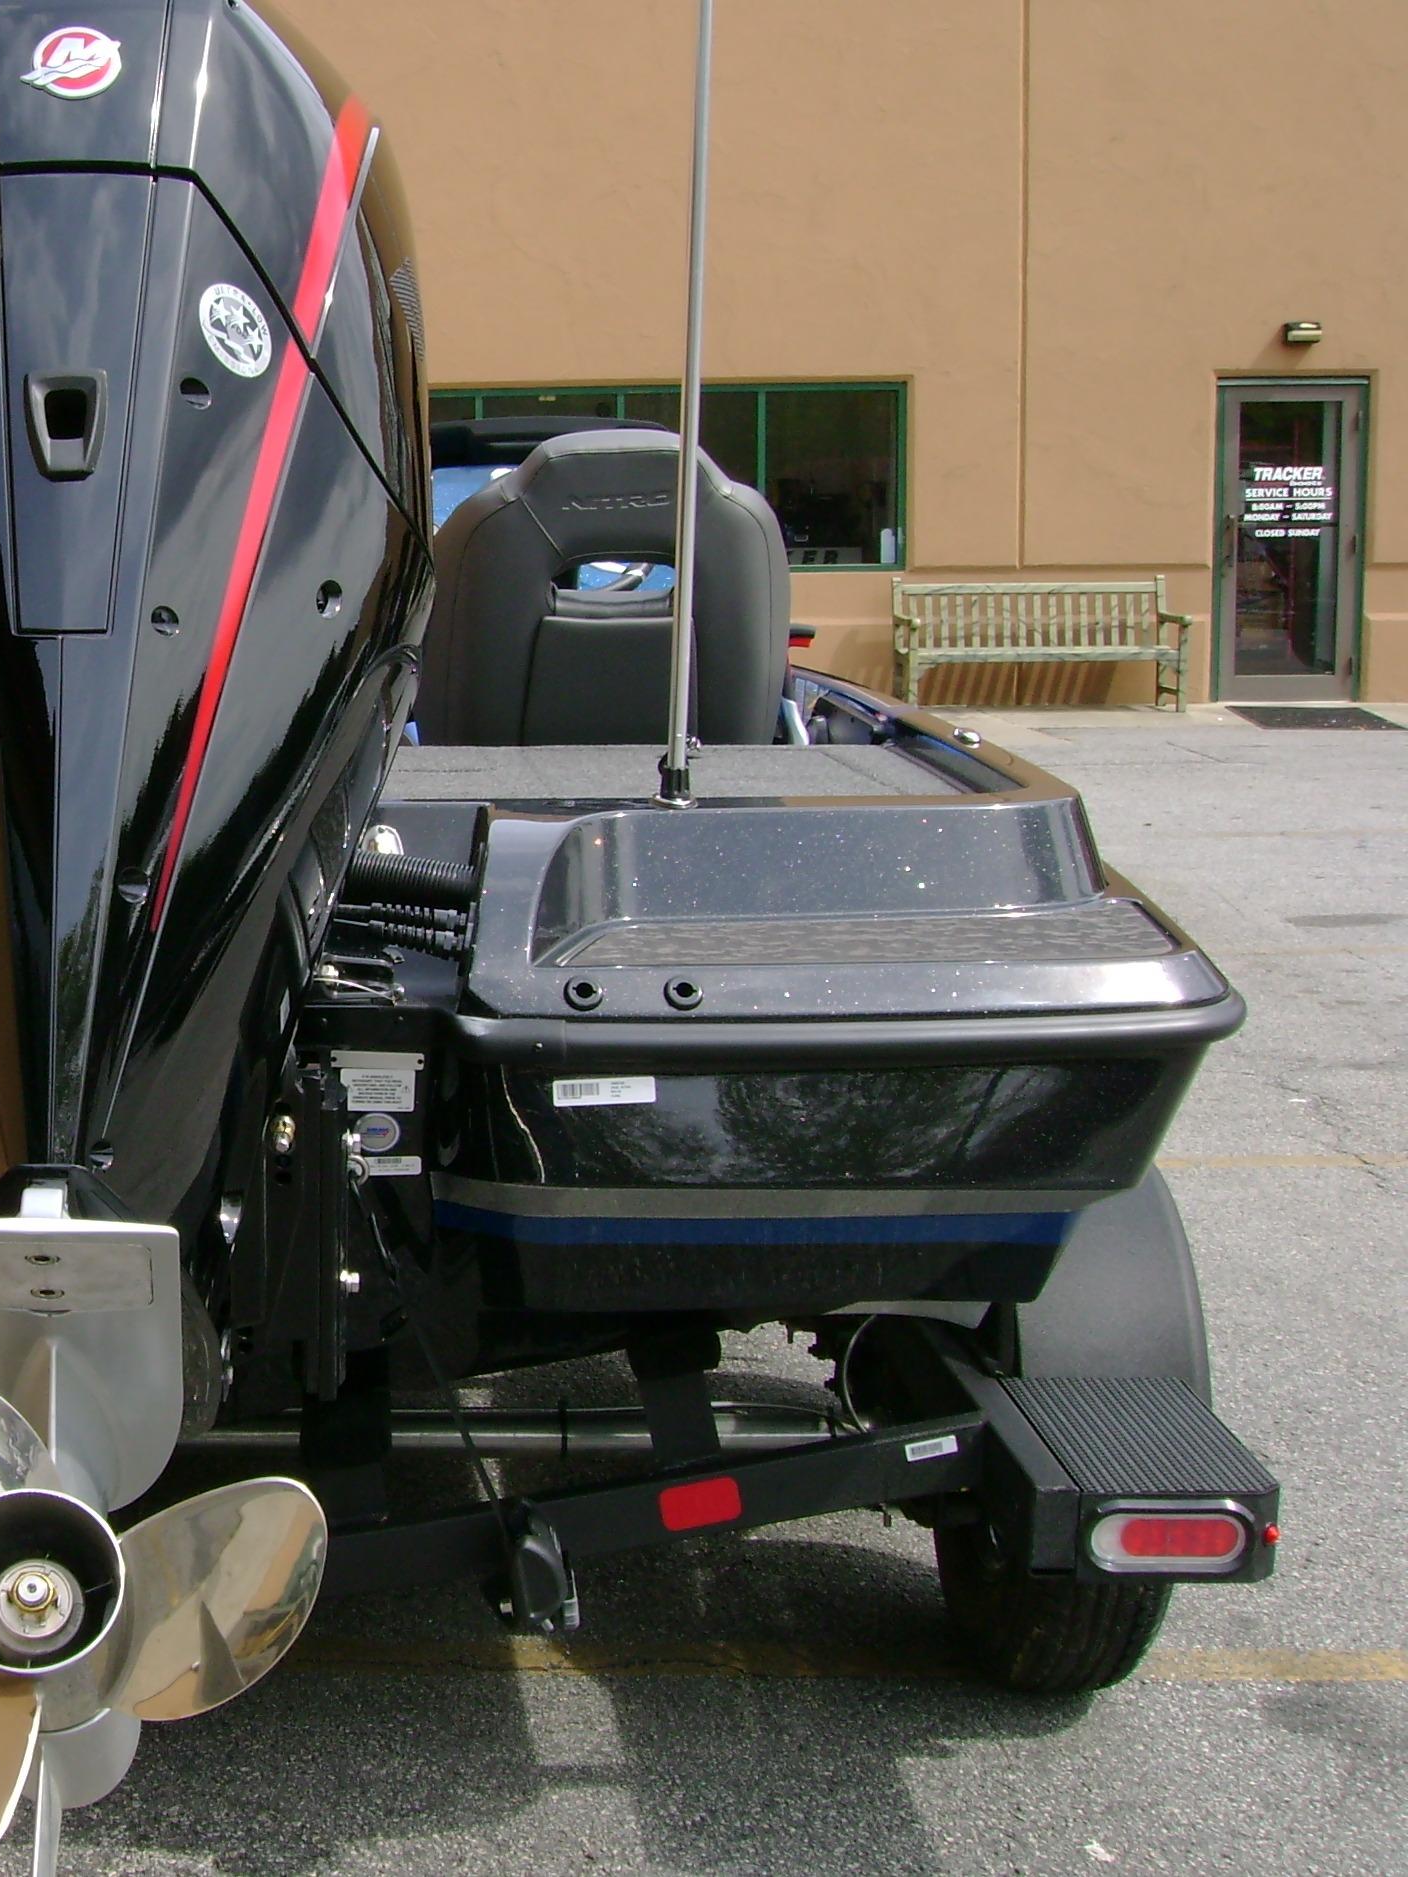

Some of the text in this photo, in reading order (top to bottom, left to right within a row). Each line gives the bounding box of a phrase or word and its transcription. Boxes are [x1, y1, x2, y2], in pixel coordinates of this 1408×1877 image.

[1253, 466, 1323, 482] TRACKER
[1245, 487, 1333, 498] SERVICE HOURS
[1291, 513, 1333, 521] SATURDAY
[1255, 528, 1320, 538] CLOSED SUNDAY
